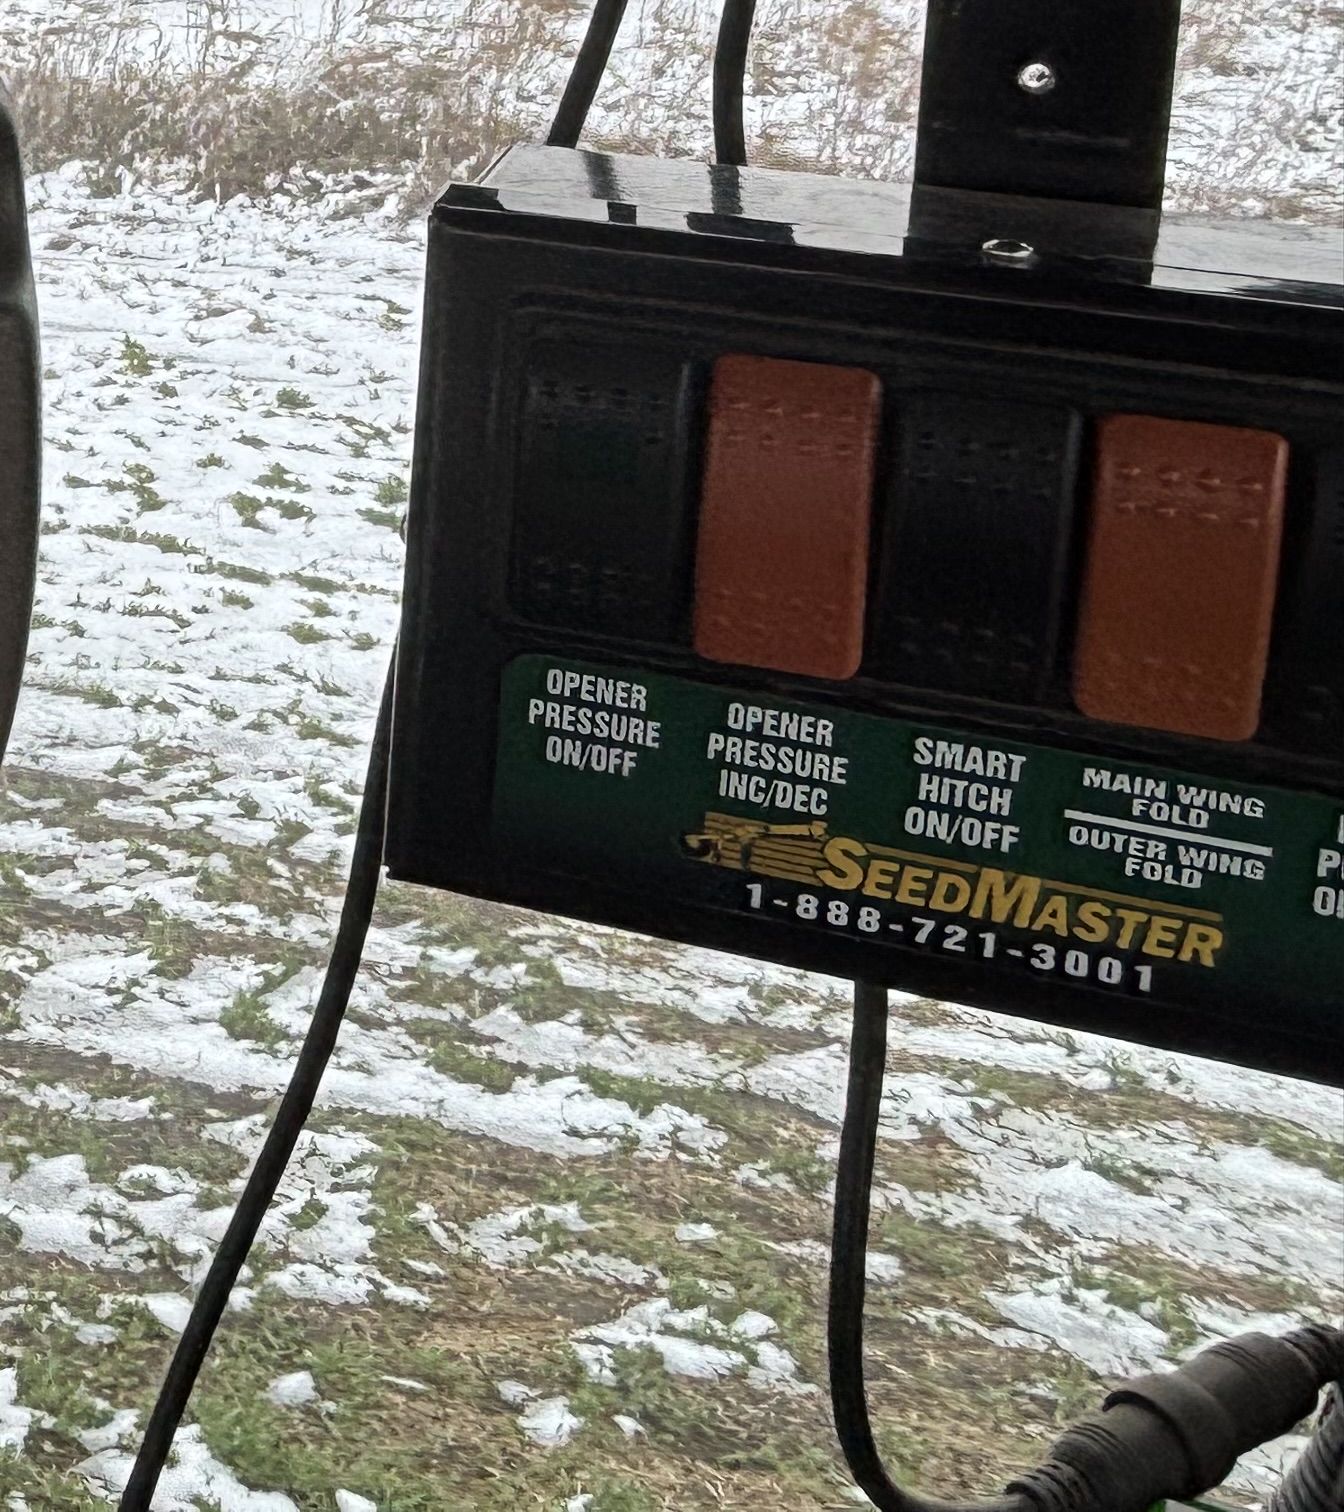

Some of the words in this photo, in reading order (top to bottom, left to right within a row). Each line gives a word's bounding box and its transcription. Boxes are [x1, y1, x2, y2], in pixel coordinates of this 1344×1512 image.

[546, 668, 648, 712] OPENER
[528, 698, 662, 748] PRESSURE
[727, 702, 834, 747] OPENER
[545, 735, 638, 776] ON/OFF
[706, 733, 849, 784] PRESSURE
[912, 737, 1027, 782] SMART
[718, 769, 828, 815] INC/DEC
[918, 773, 1013, 816] HITCH
[1082, 768, 1167, 798] MAIN
[1176, 784, 1266, 819] WING
[1131, 798, 1210, 829] FOLD
[903, 807, 1020, 853] ON/OFF
[1068, 826, 1167, 861] OUTER
[1177, 845, 1266, 881] WING
[1124, 857, 1203, 889] FOLD
[746, 883, 1154, 992] 1-888-721-3001
